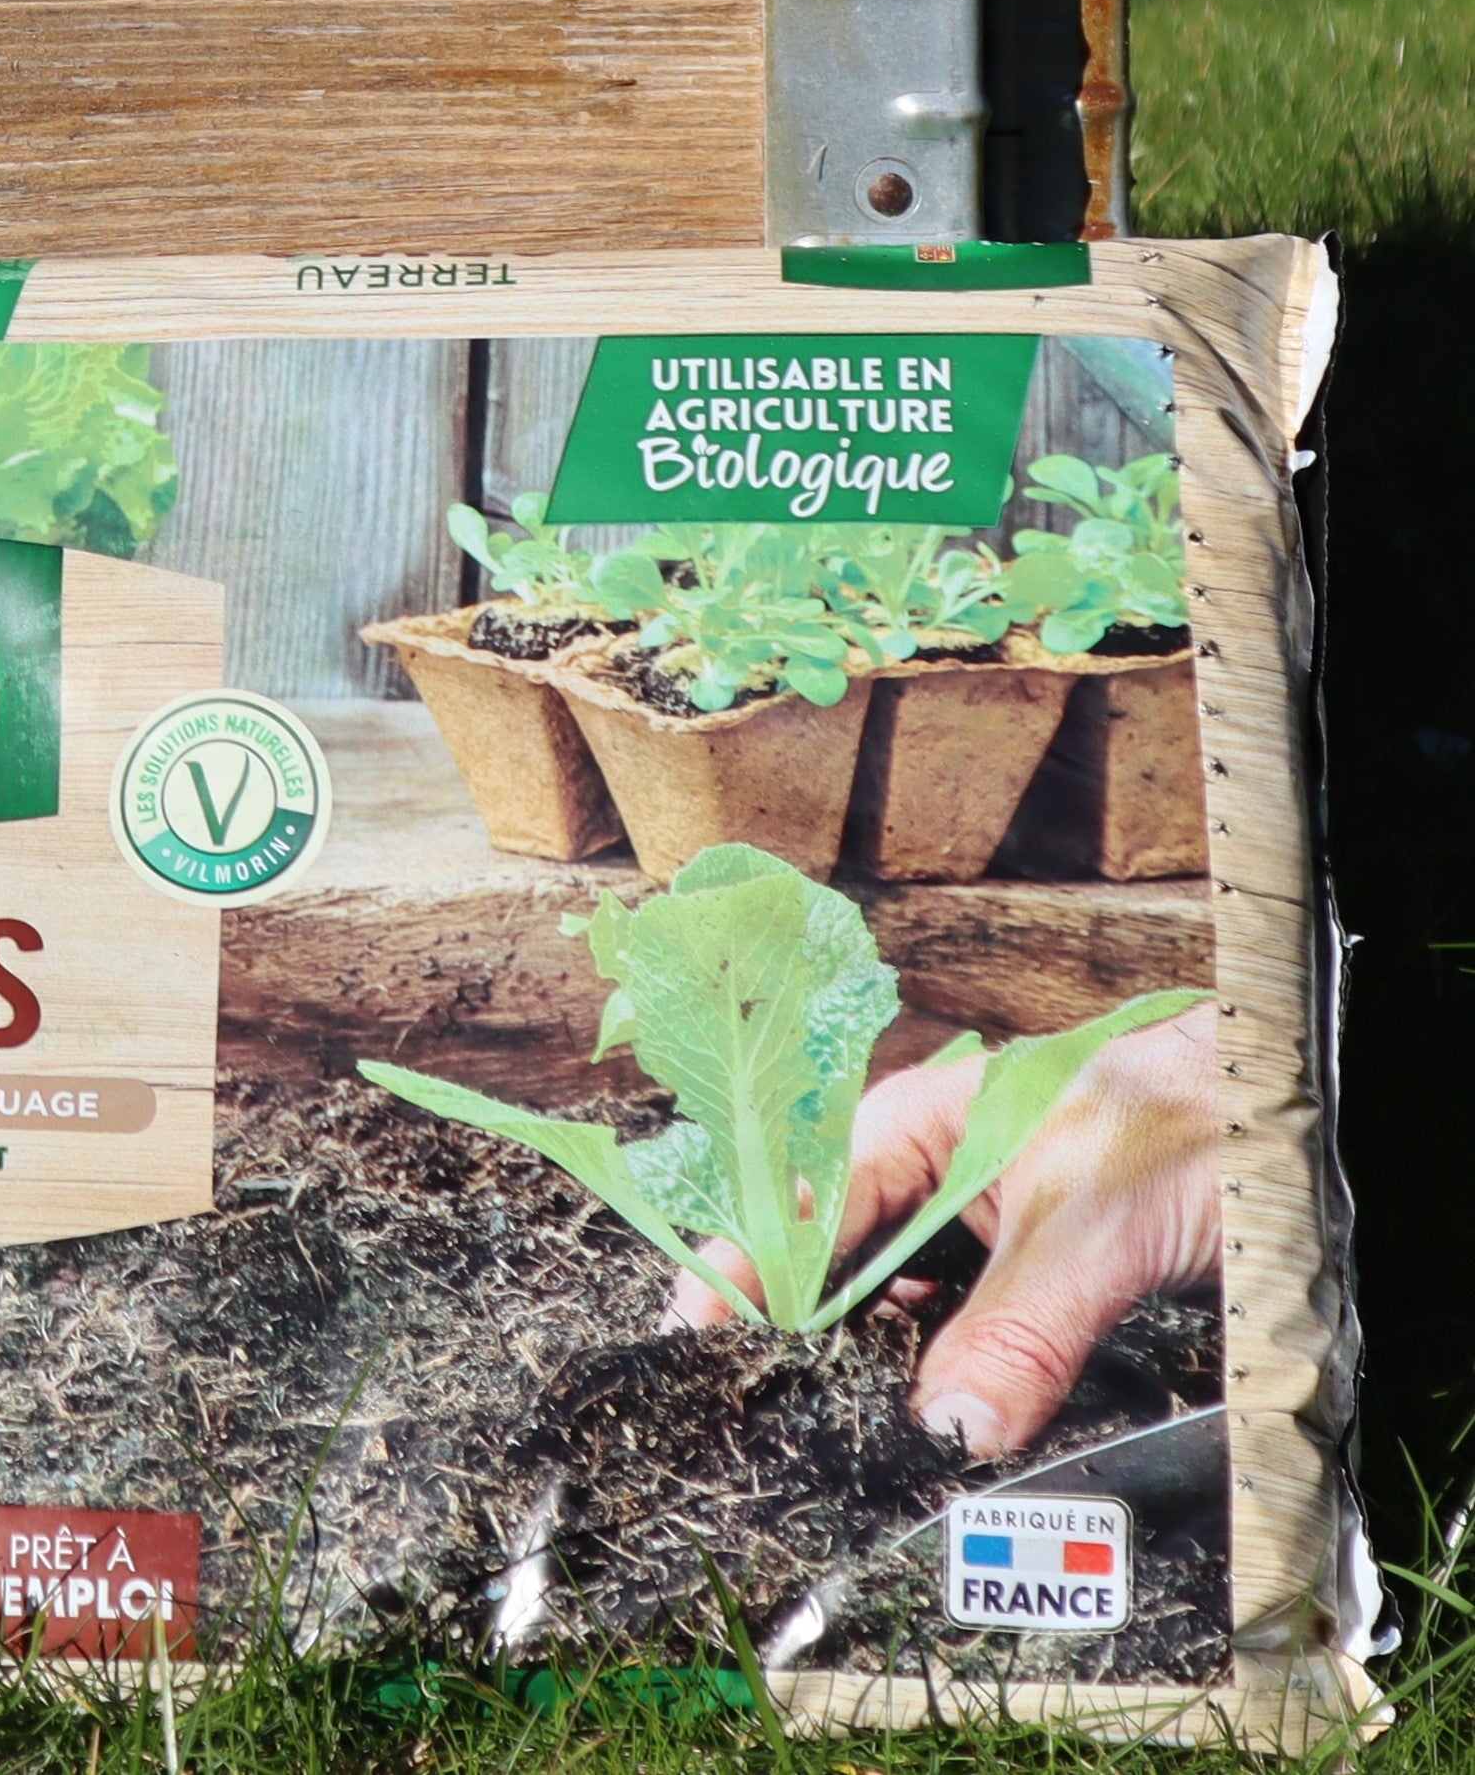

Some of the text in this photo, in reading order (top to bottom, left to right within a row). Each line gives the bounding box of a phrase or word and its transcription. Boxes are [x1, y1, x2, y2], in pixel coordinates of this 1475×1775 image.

[296, 262, 517, 291] TERREAU
[651, 356, 952, 392] UTILISABLE EN
[645, 397, 954, 433] AGRICULTURE
[636, 432, 954, 519] Biologique
[136, 713, 306, 825] LES SOLUTIONS NATURELLES
[172, 835, 292, 885] VILMORIN
[962, 1509, 1116, 1535] FABRIQUÉ EN
[10, 1525, 137, 1573] PRÊT À
[962, 1578, 1115, 1620] FRANCE
